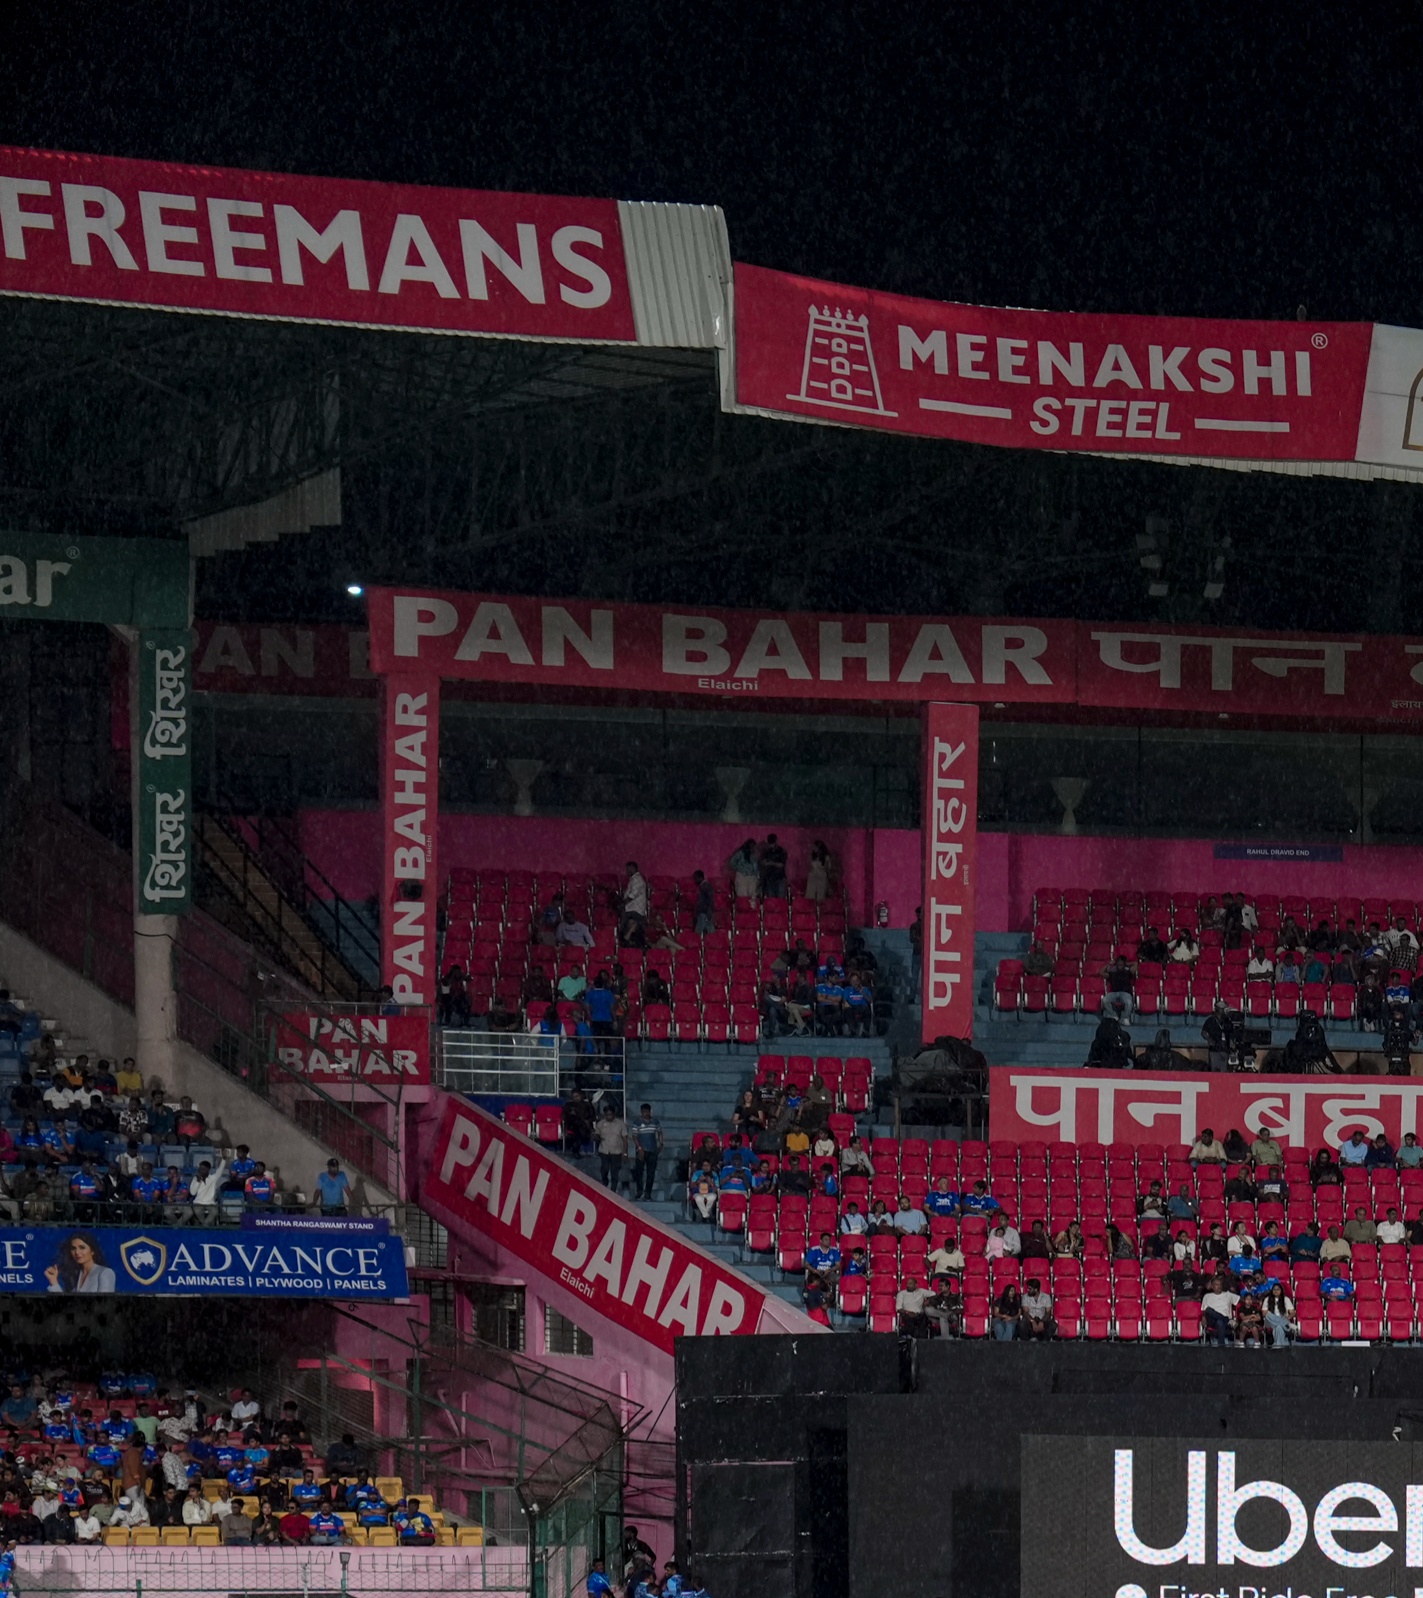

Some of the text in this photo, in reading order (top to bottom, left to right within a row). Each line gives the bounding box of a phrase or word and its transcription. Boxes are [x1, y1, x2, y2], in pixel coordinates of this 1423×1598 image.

[0, 175, 611, 308] FREEMANS
[898, 324, 1311, 397] MEENAKSHI
[1030, 396, 1181, 440] STEEL
[394, 596, 614, 670] PAN
[662, 613, 1053, 685] BAHAR
[1091, 632, 1362, 694] पान
[698, 678, 758, 691] Elaichi
[393, 692, 427, 1004] PAN BAHAR
[929, 736, 966, 1010] पान बहार
[309, 1017, 388, 1044] PAN
[1010, 1075, 1209, 1145] पान
[256, 1219, 374, 1230] SHANTHA RANGASWAMY STAND
[440, 1113, 745, 1335] PAN BAHAR
[168, 1243, 382, 1277] ADVANCE
[168, 1275, 386, 1291] LAMINATES PLYWOOD PANELS
[559, 1266, 594, 1299] Elaichi
